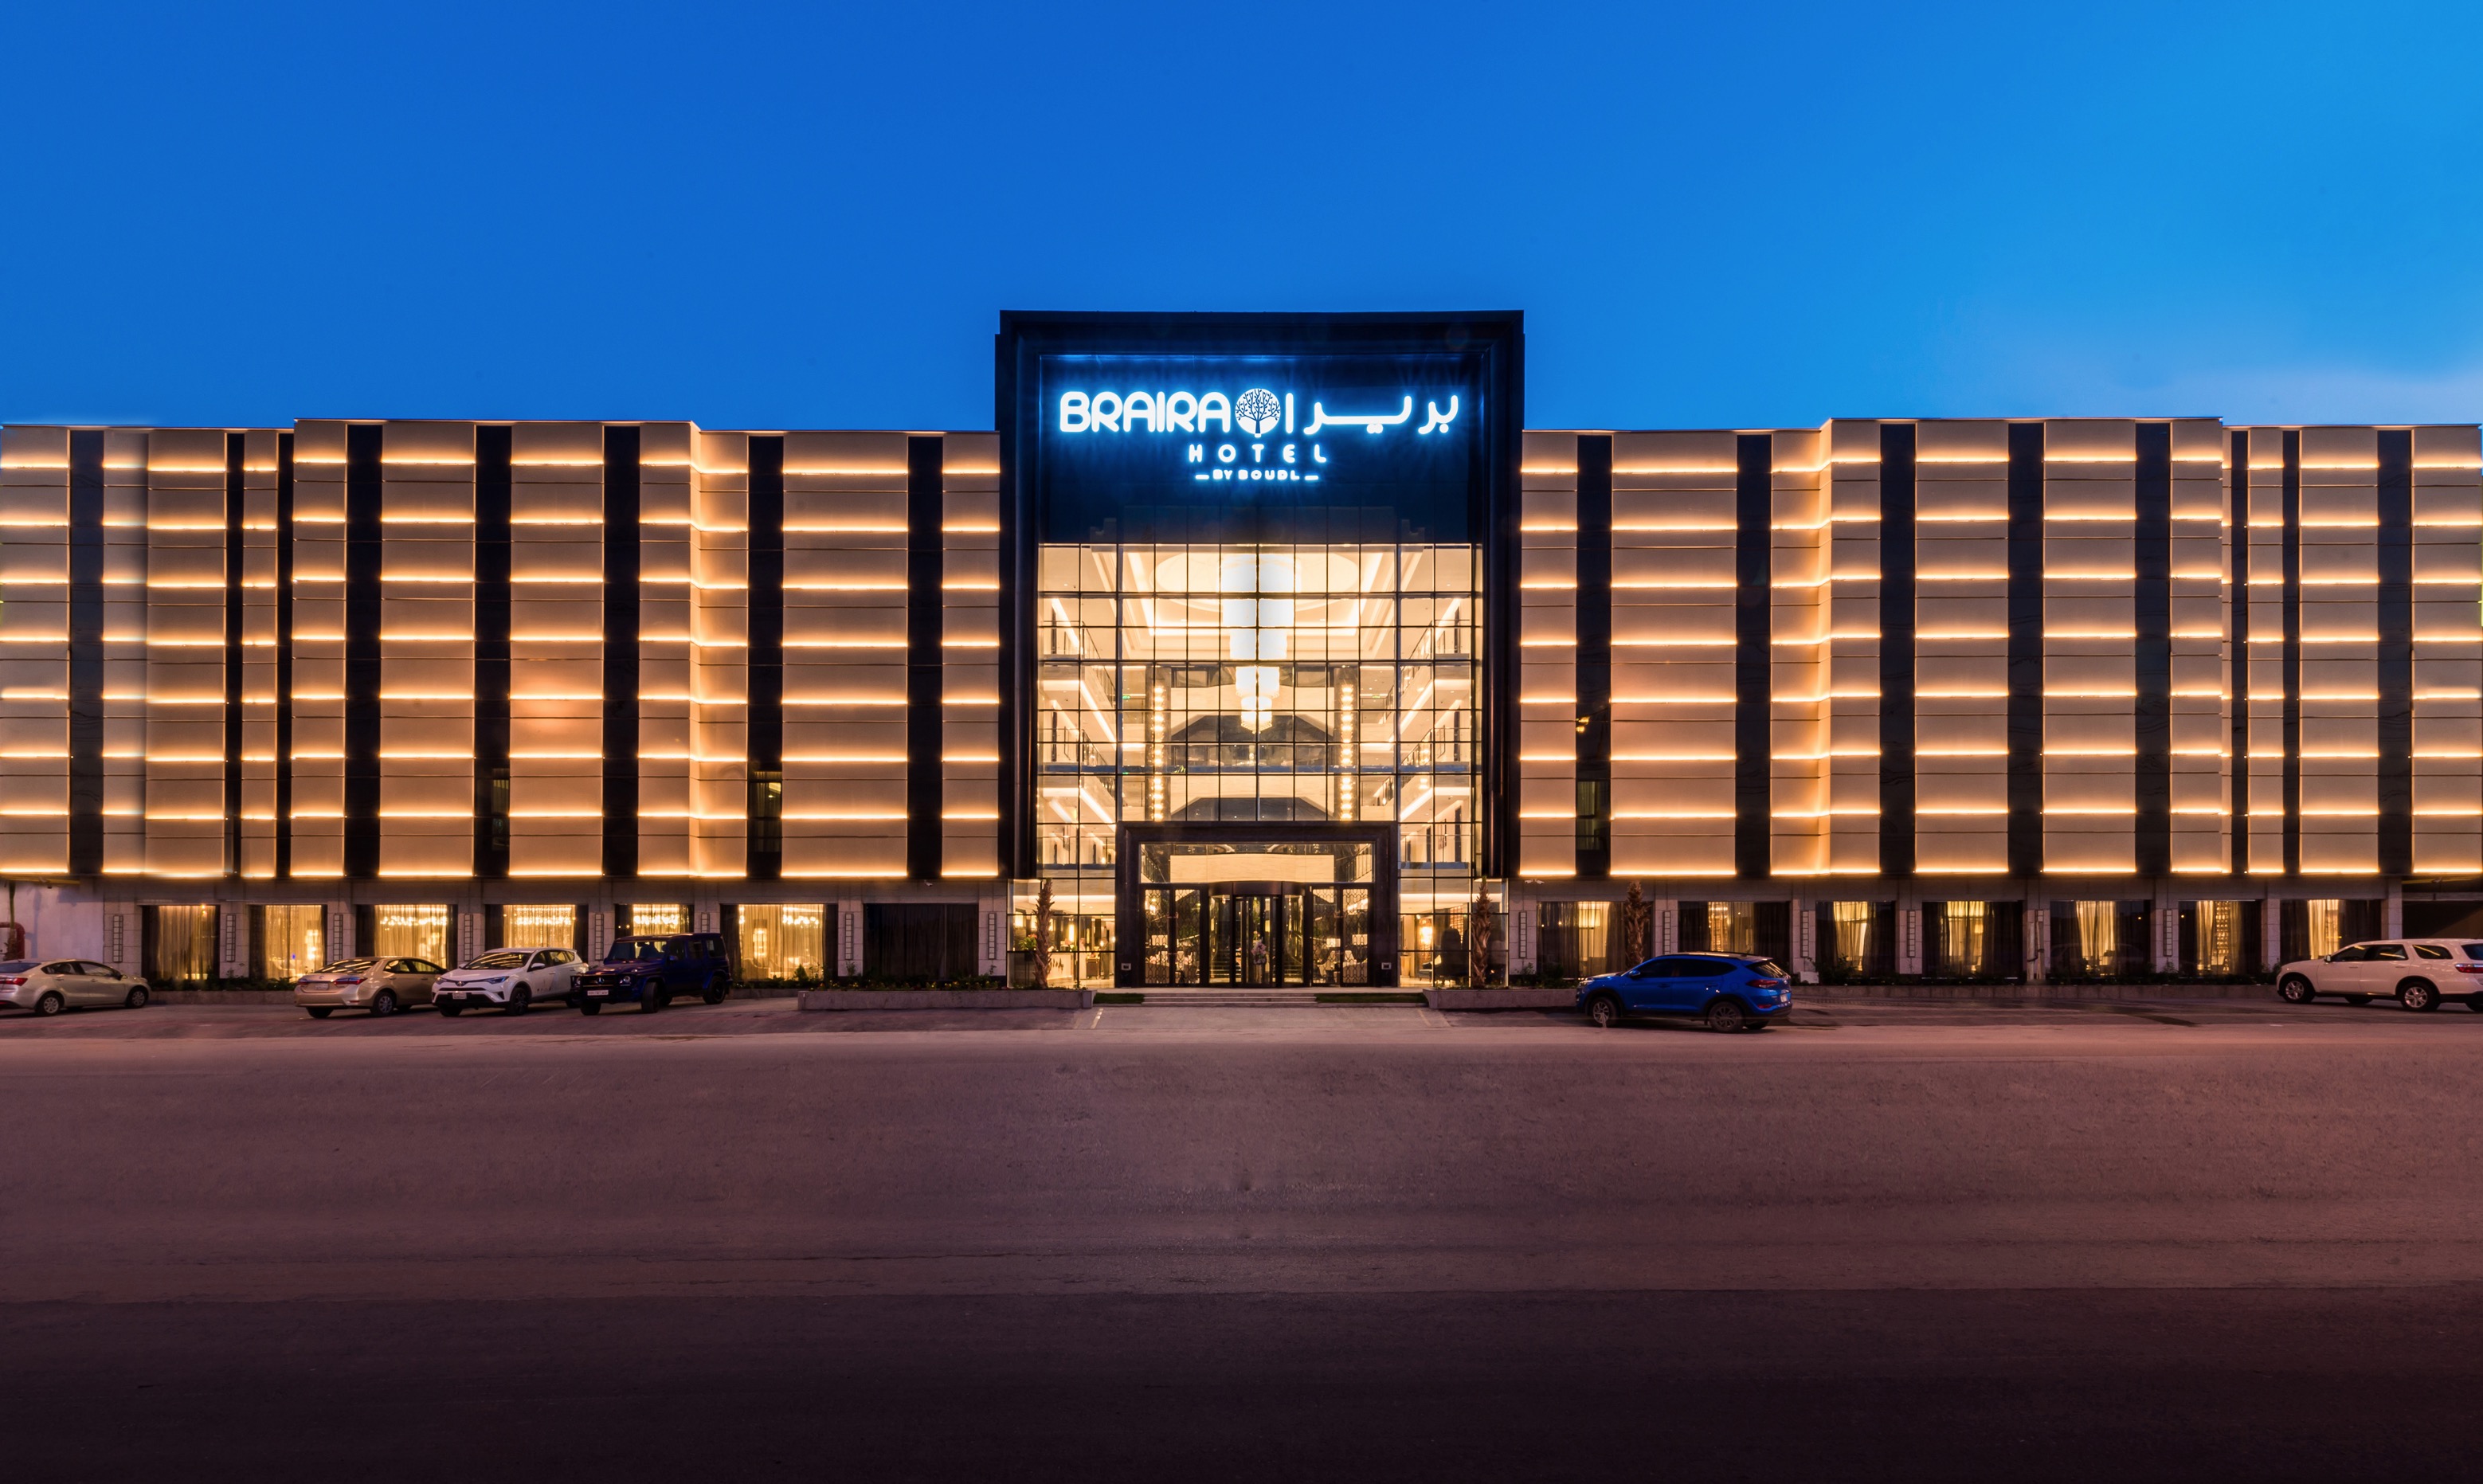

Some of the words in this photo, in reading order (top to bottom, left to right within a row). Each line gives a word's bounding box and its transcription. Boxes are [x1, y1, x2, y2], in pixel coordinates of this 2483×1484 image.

[1059, 390, 1232, 433] BRAIRA
[1189, 443, 1327, 464] HOTEL
[1212, 468, 1233, 480] BY
[1237, 468, 1301, 481] BOUDL
